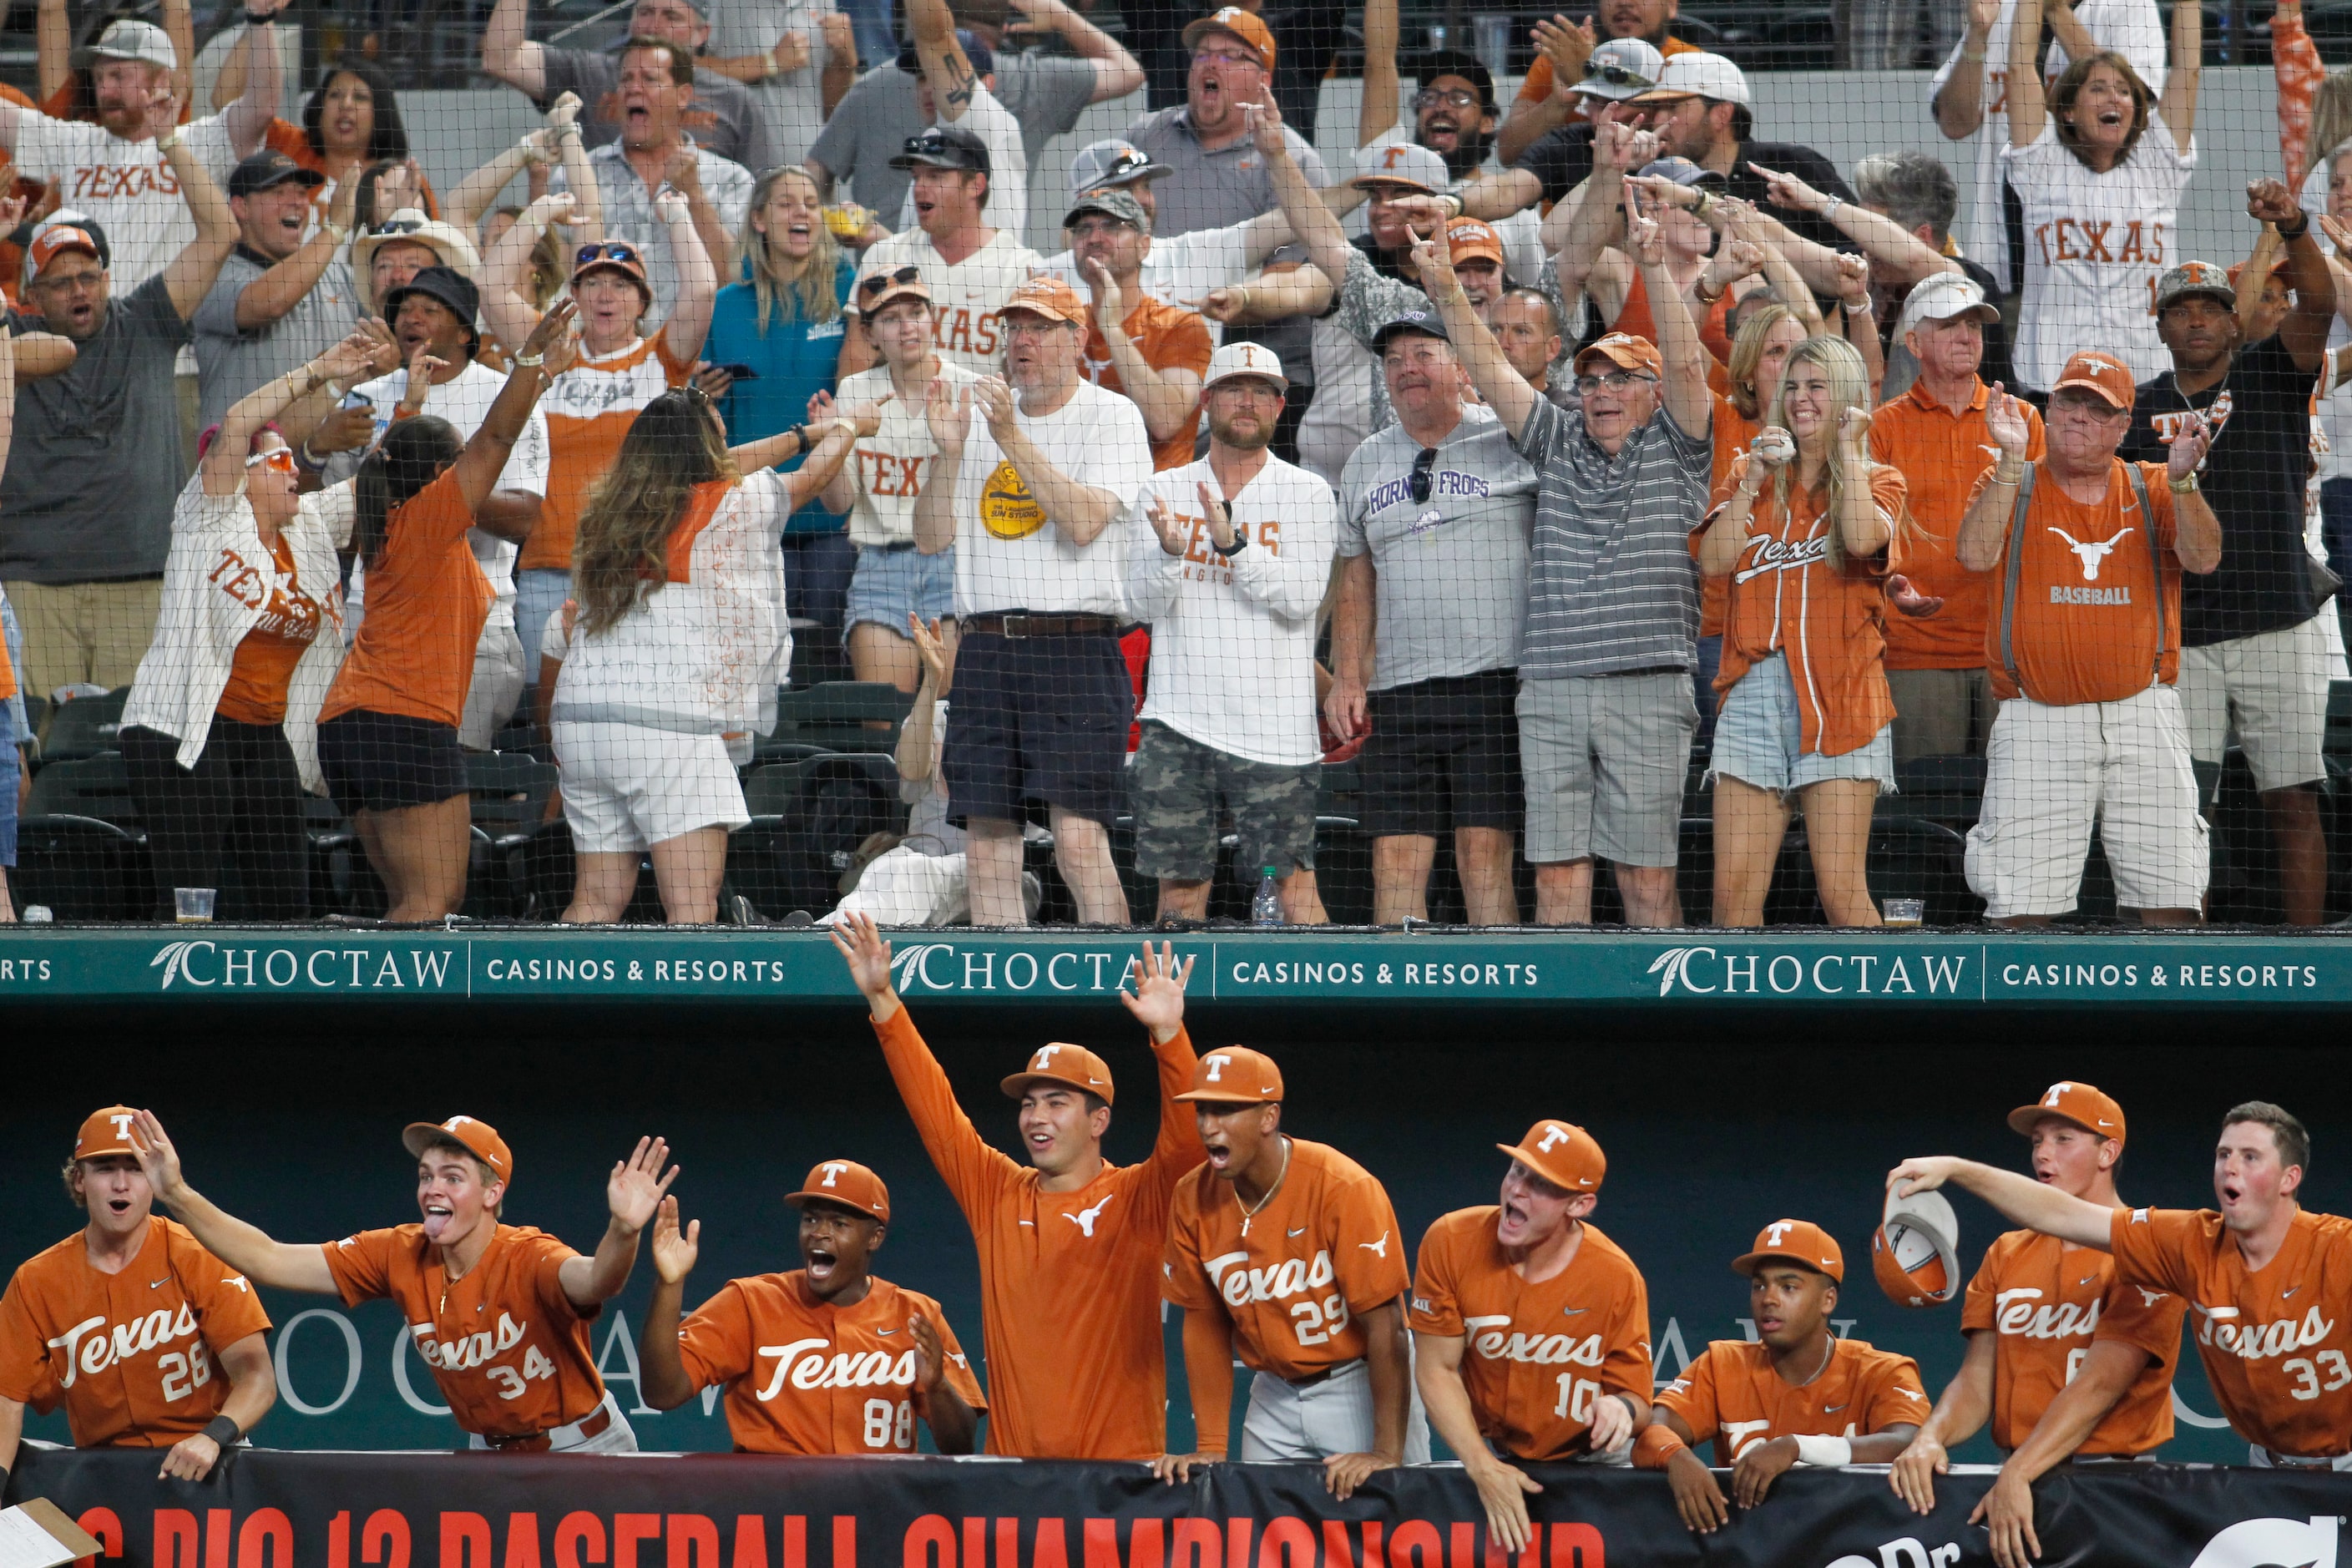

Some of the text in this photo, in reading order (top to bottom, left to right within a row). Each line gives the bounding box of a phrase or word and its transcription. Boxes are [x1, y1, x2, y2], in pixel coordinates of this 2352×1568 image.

[1383, 147, 1406, 169] T
[74, 160, 178, 198] TEXAS
[2035, 218, 2163, 266] TEXAS
[2180, 263, 2207, 284] T
[1240, 346, 1257, 367] T
[1437, 469, 1490, 498] FROGS
[990, 510, 1039, 519] SUN STUDIO
[1744, 533, 1828, 568] Texa
[2050, 585, 2132, 604] BASEBALL
[1, 959, 51, 980] RTS
[180, 940, 453, 989] CHOCTAW
[487, 959, 784, 982] CASINOS & RESORTS
[1232, 961, 1538, 986] CASINOS & RESORTS
[1679, 947, 1966, 994] CHOCTAW
[2003, 964, 2317, 988] CASINOS & RESORTS
[1035, 1044, 1060, 1070] T
[1206, 1055, 1232, 1082] T
[2044, 1083, 2072, 1108] T
[109, 1115, 135, 1141] T
[443, 1115, 471, 1132] T
[1536, 1124, 1570, 1153] T
[822, 1163, 847, 1187] T
[1767, 1222, 1793, 1246] T
[1204, 1250, 1333, 1308] Texas
[1290, 1293, 1349, 1347] 29
[2192, 1301, 2334, 1360] Texas
[48, 1300, 197, 1389] Texas
[405, 1312, 527, 1371] Texas
[1463, 1314, 1605, 1367] Texas
[158, 1339, 211, 1403] 28
[486, 1344, 557, 1400] 34
[756, 1338, 916, 1402] Texas
[2282, 1349, 2352, 1401] 33
[1555, 1372, 1601, 1423] 10
[863, 1398, 911, 1449] 88
